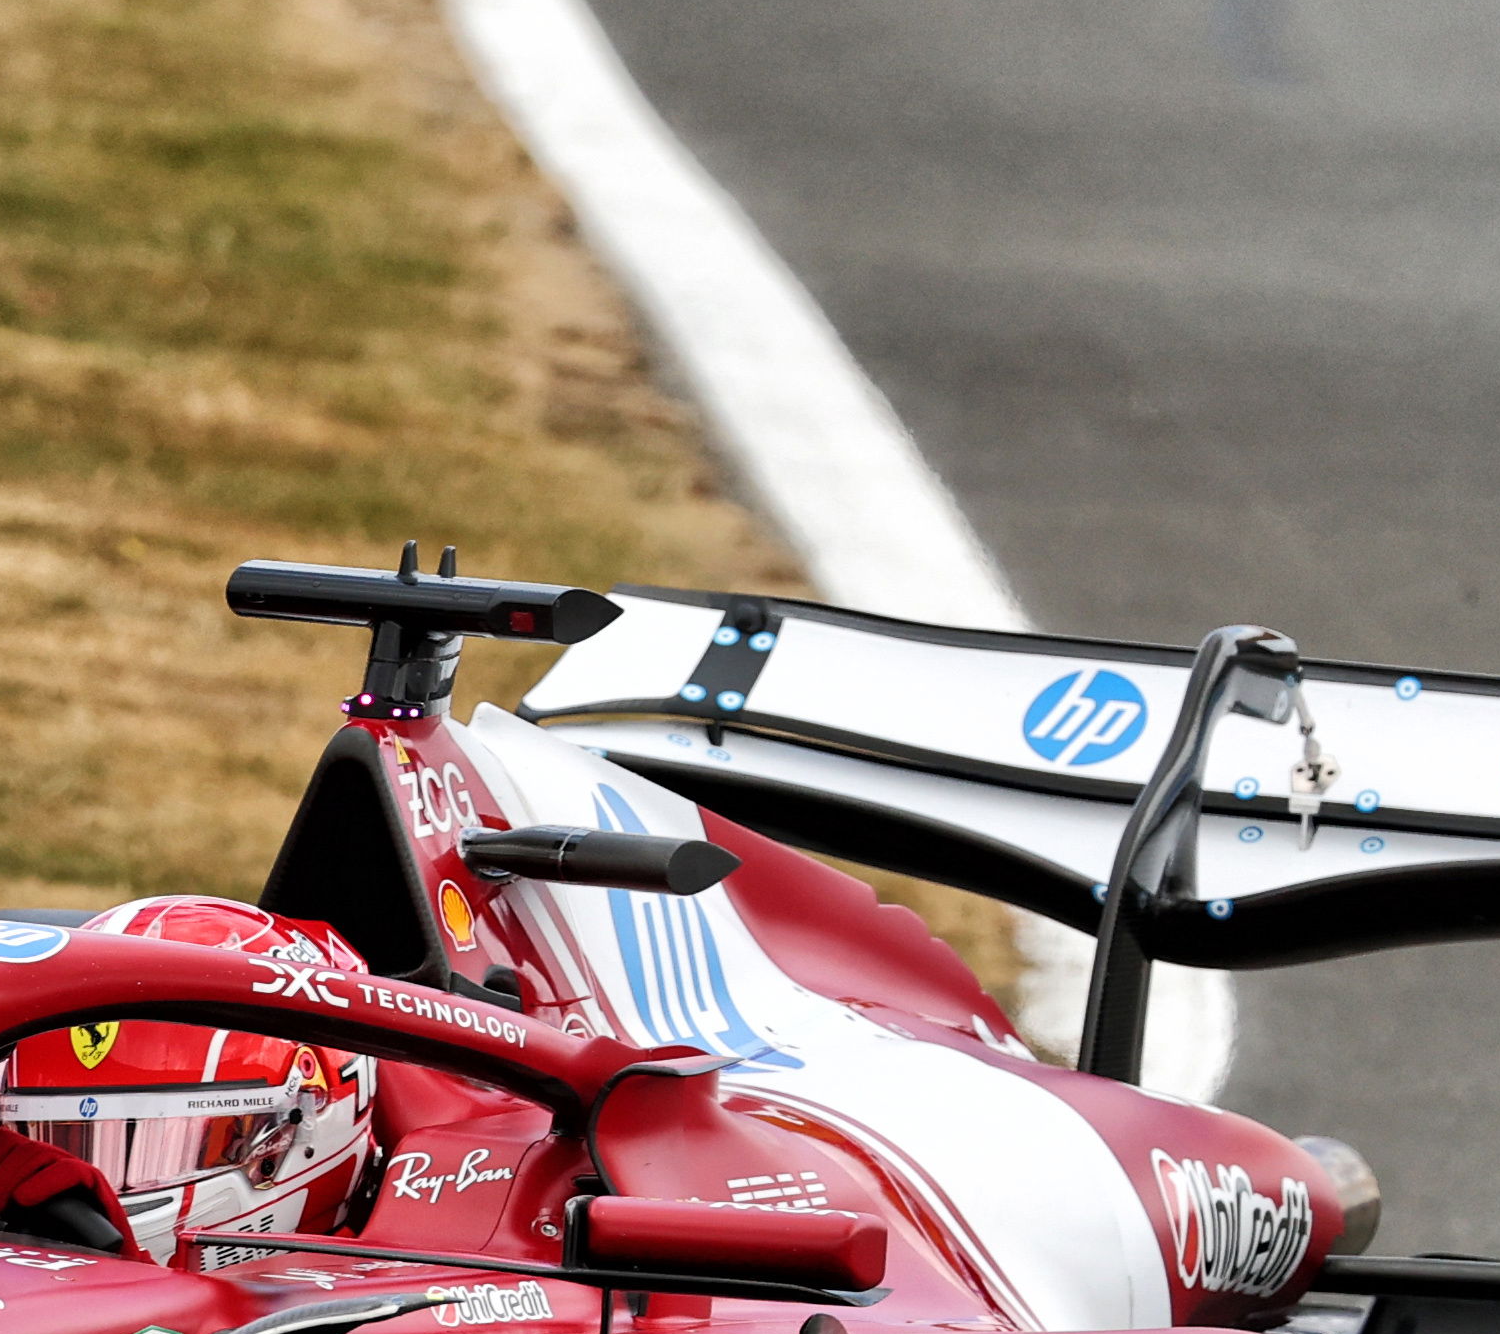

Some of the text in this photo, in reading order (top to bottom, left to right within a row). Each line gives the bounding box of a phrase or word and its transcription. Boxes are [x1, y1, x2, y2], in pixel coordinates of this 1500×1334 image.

[1028, 669, 1132, 765] hp
[248, 958, 528, 1049] DXC TECHNOLOGY
[187, 1096, 275, 1110] RICHARD MILLE
[386, 1148, 514, 1204] Ray-Ban
[457, 1281, 552, 1324] UniCredit
